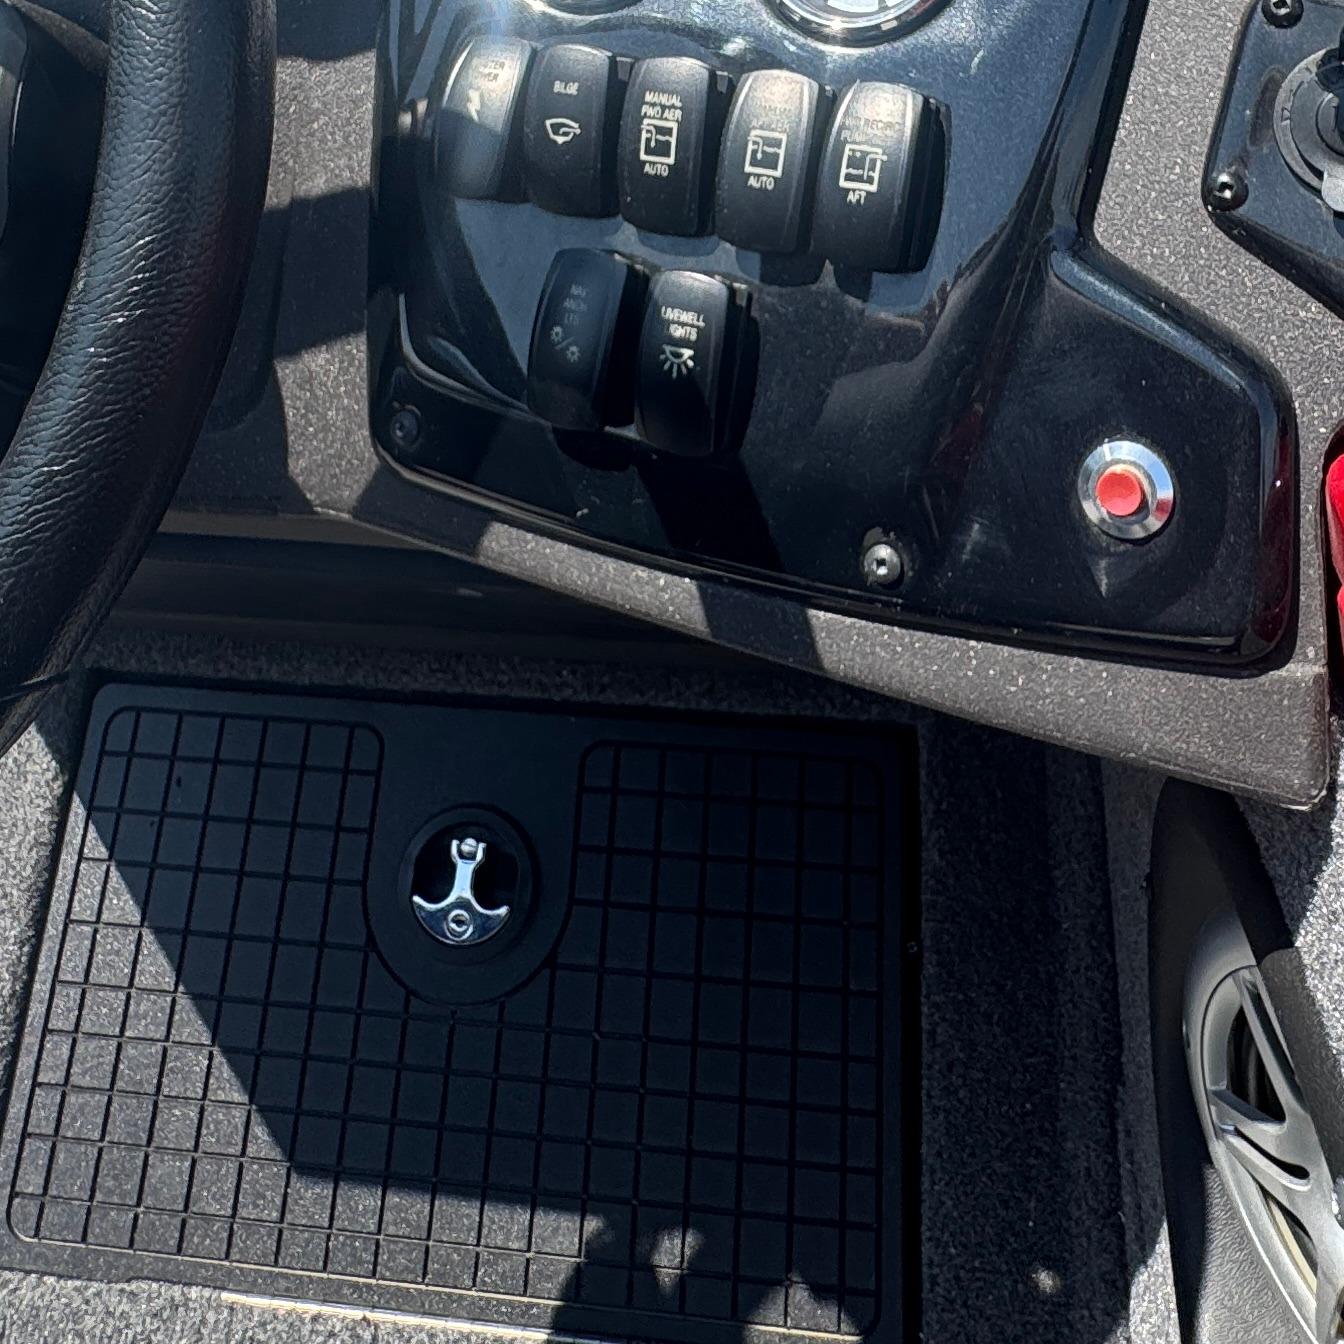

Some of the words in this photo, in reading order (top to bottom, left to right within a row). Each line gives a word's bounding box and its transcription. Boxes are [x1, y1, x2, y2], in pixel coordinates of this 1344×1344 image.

[553, 80, 579, 96] BILGE
[644, 90, 683, 108] MANUAL
[640, 104, 662, 118] FWD
[662, 107, 683, 123] AER
[643, 162, 669, 177] AUTO
[747, 175, 775, 191] AUTO
[846, 190, 867, 206] AFT
[661, 305, 706, 327] LIVEWELL
